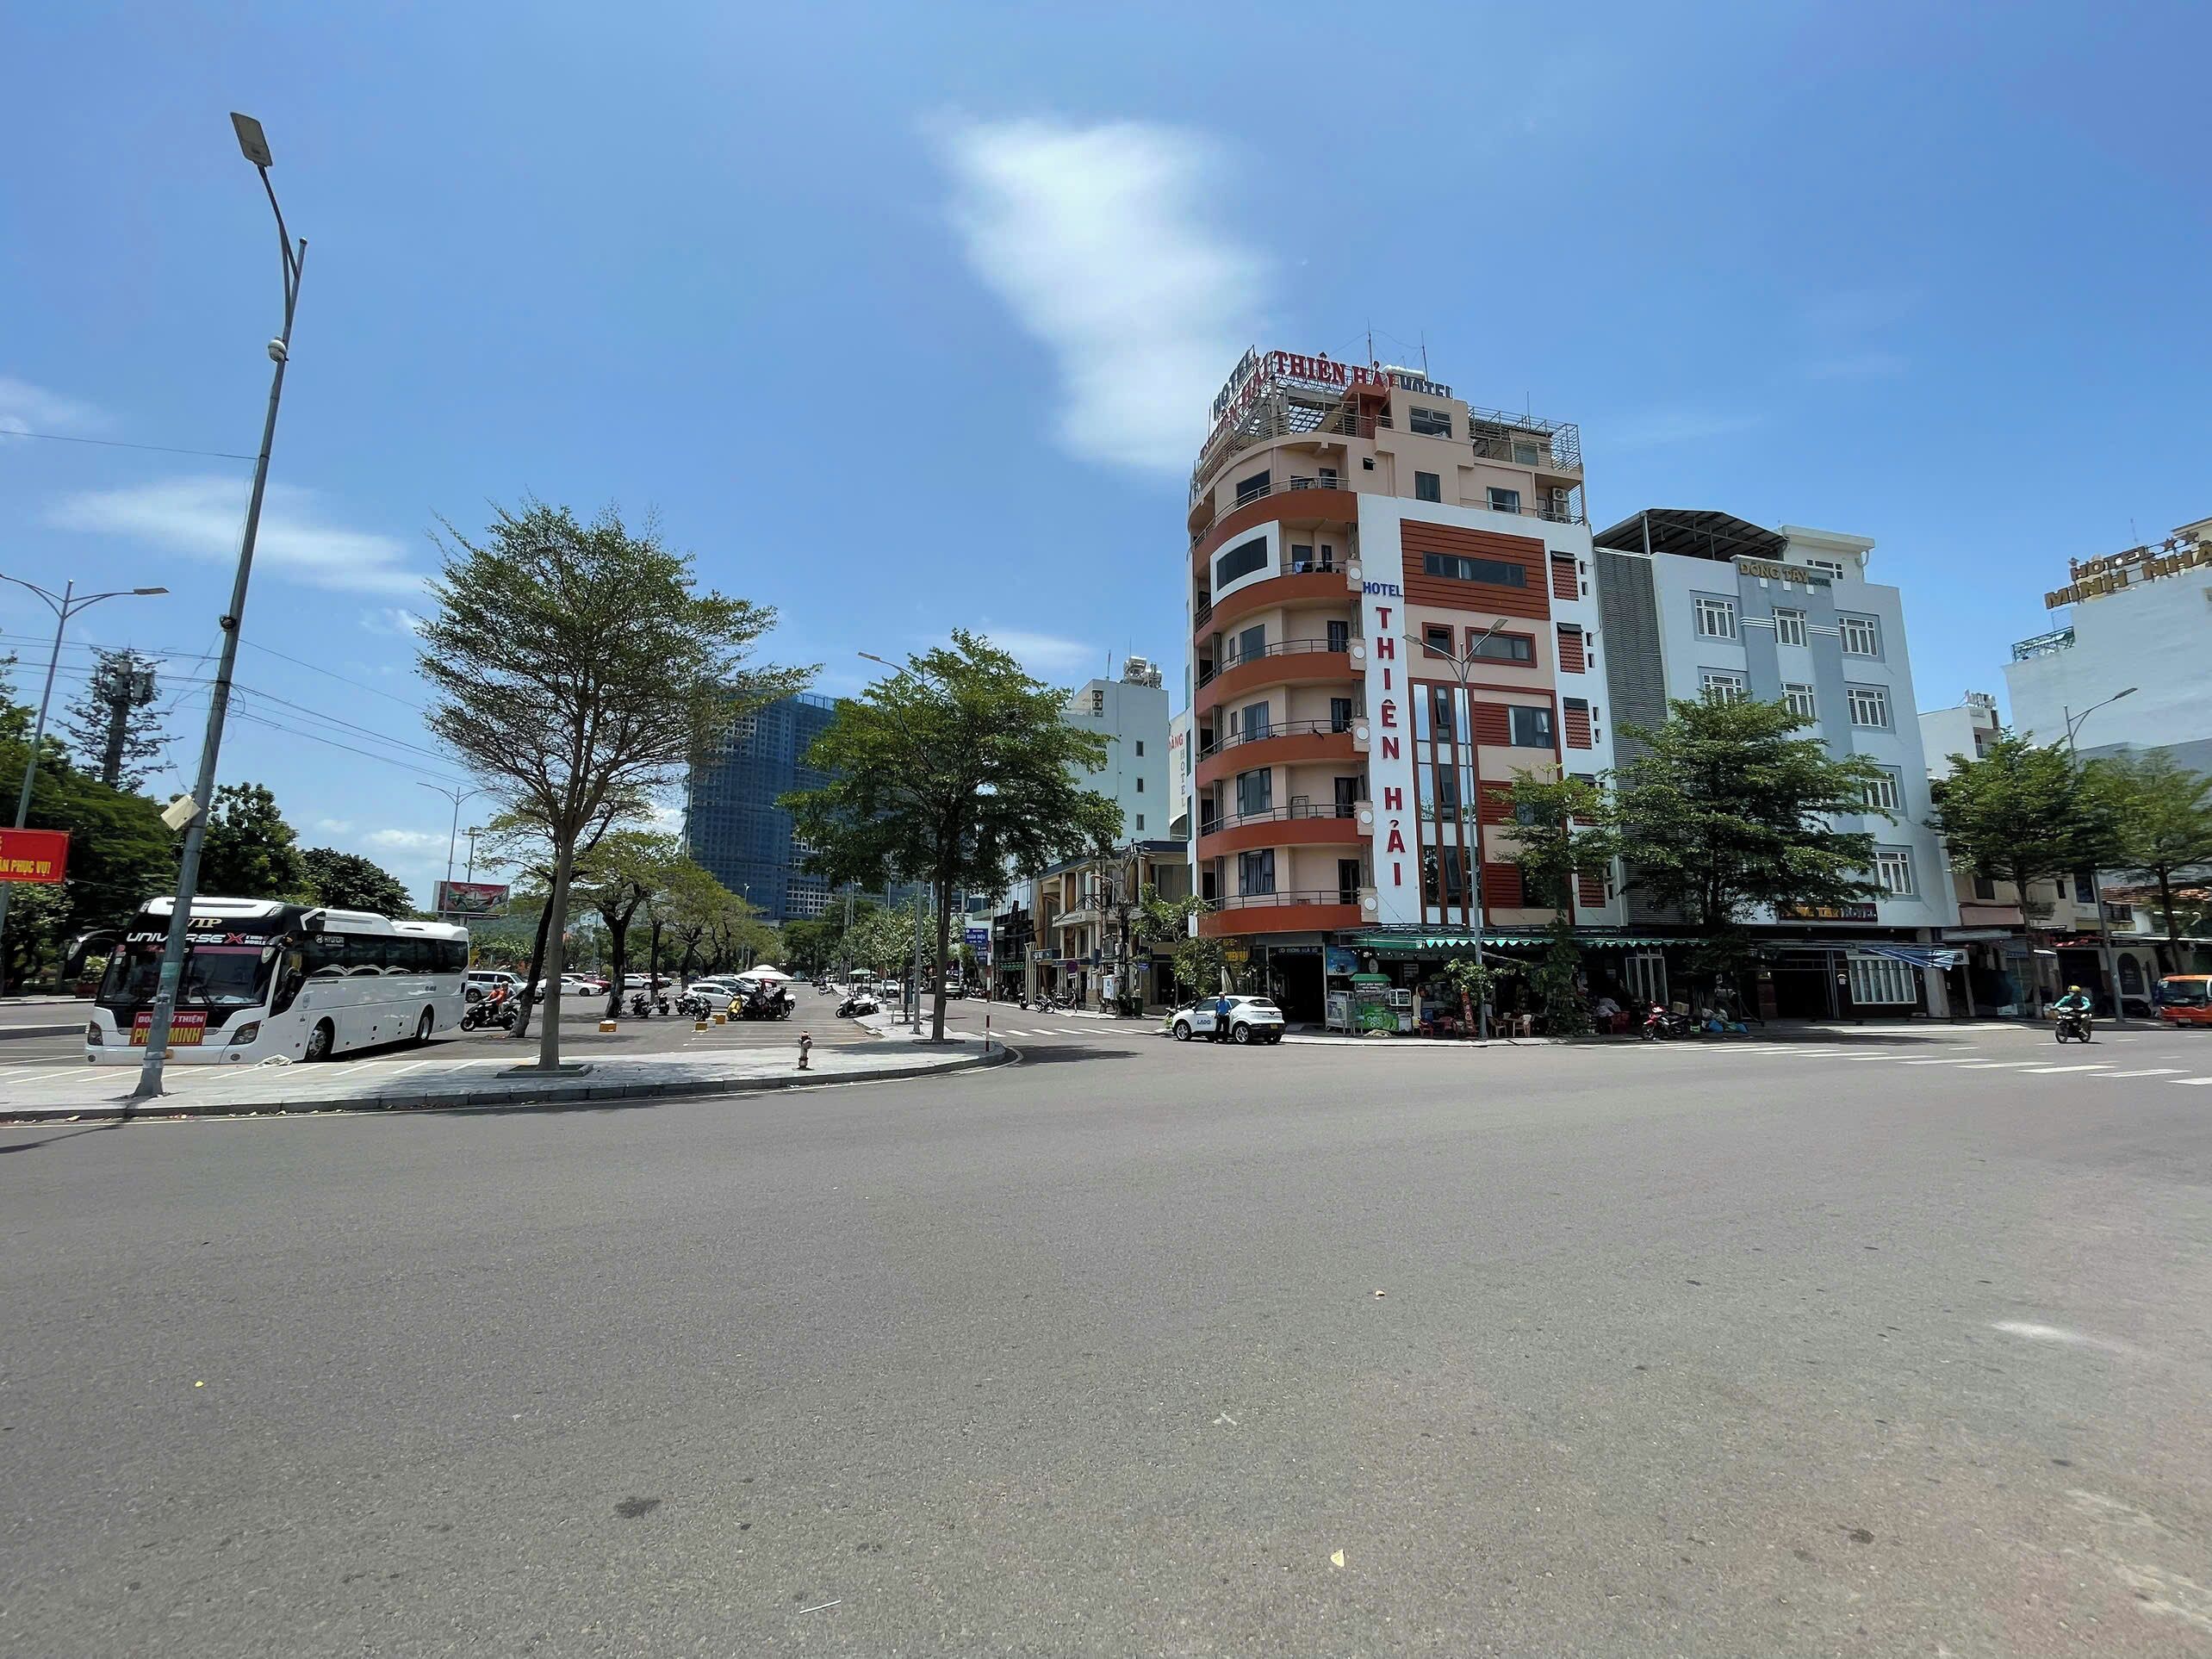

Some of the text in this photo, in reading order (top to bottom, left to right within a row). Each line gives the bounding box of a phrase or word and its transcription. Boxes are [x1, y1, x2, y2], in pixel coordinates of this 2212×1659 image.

[1273, 350, 1347, 387] THIÊN
[2071, 545, 2156, 582] HOTEL
[1363, 581, 1403, 597] HOTEL
[2044, 569, 2128, 610] MINH
[1376, 606, 1406, 886] THIÊN HẢI
[126, 932, 227, 944] UNIVRSE
[168, 1028, 202, 1042] MINH
